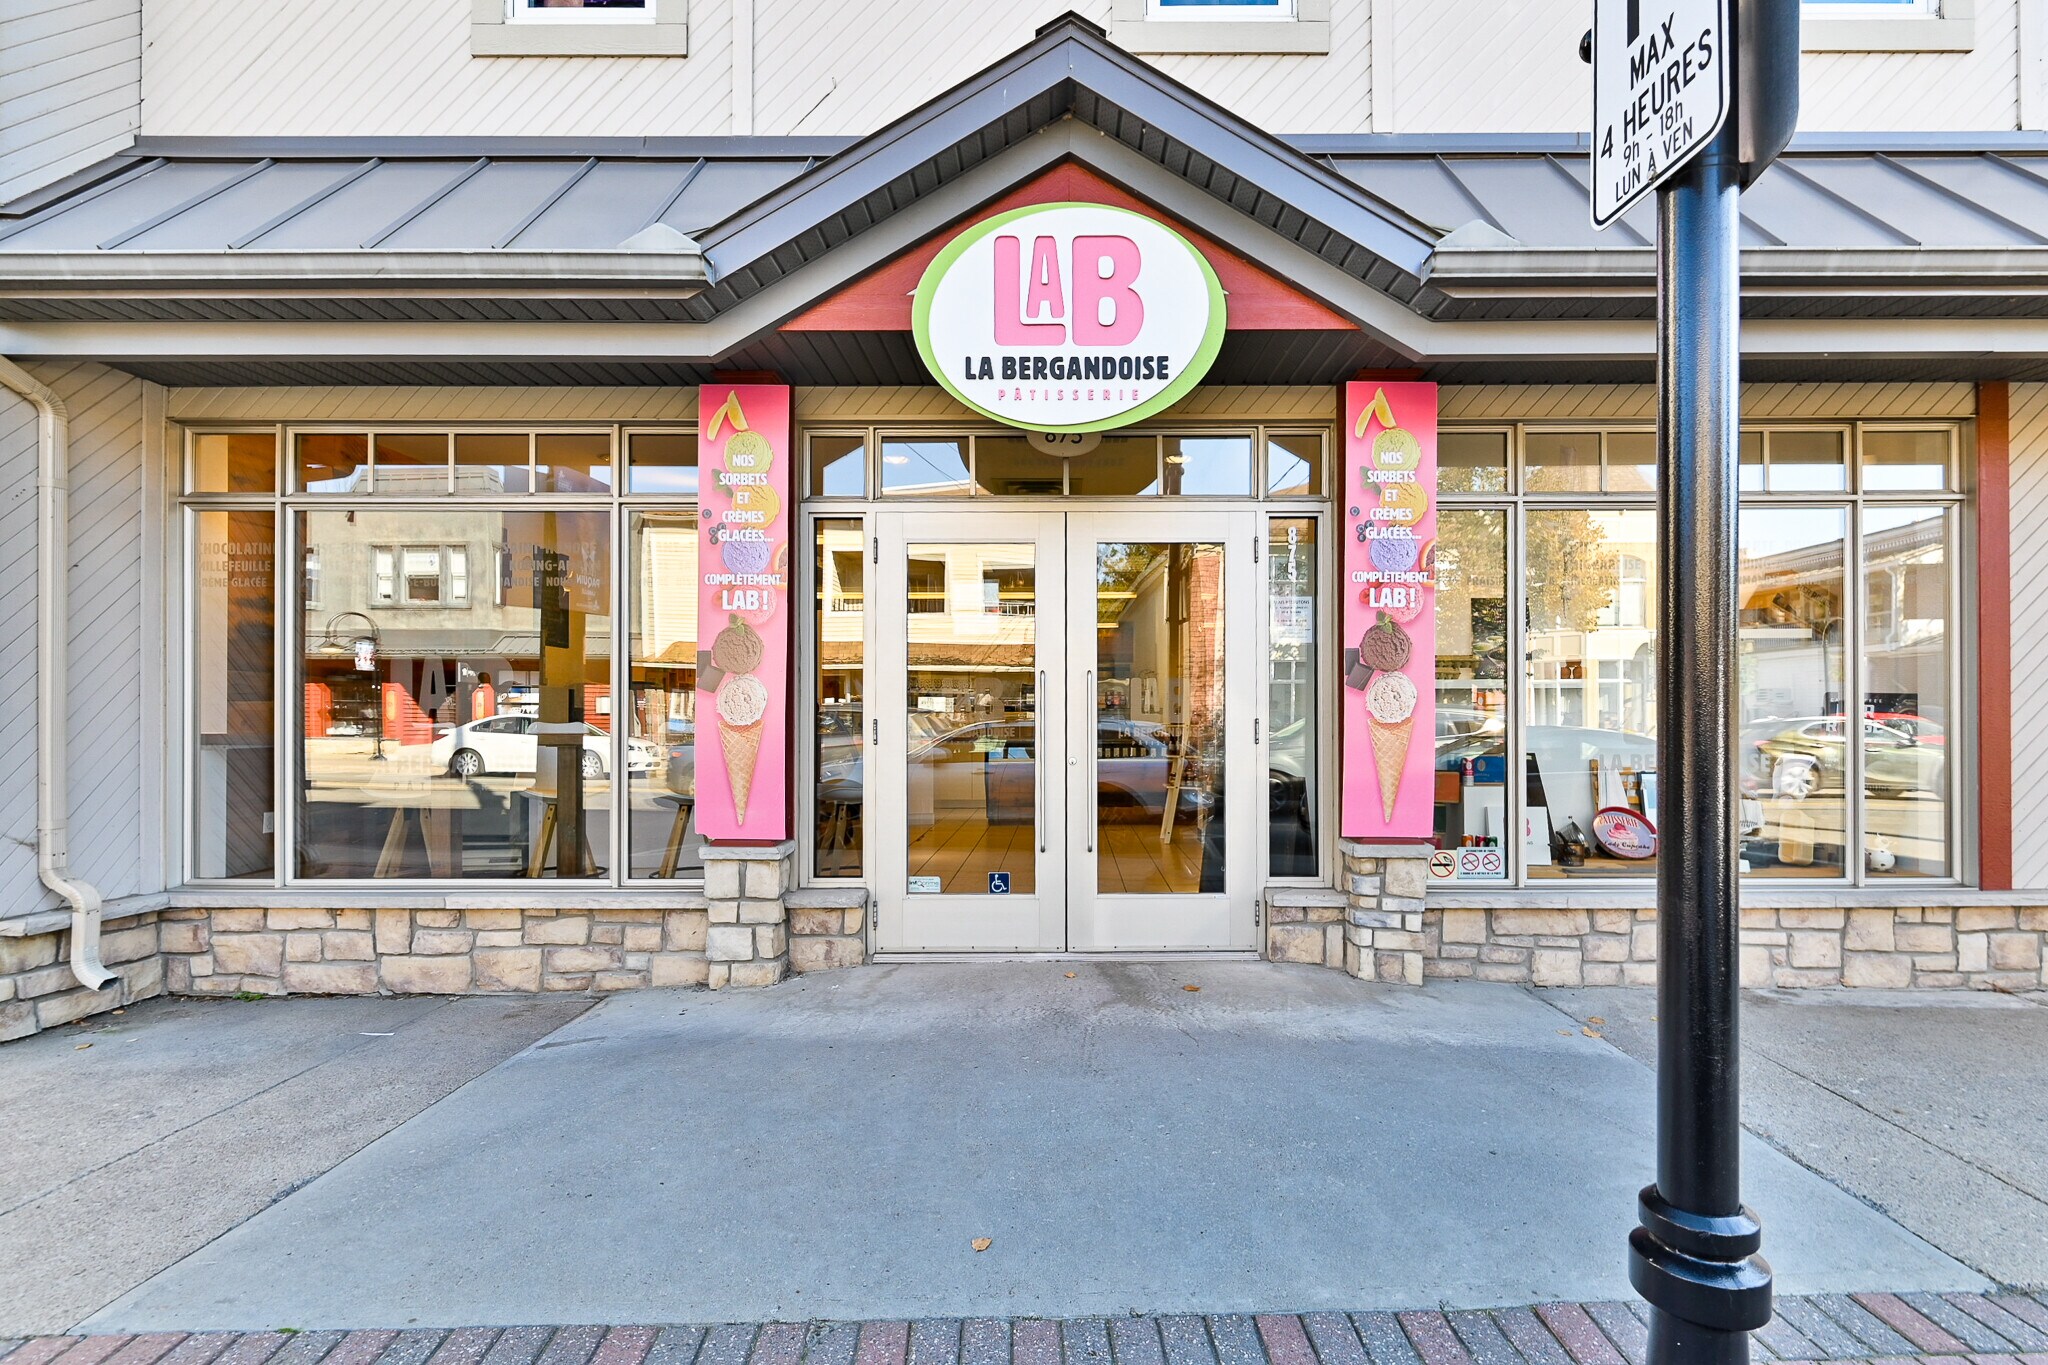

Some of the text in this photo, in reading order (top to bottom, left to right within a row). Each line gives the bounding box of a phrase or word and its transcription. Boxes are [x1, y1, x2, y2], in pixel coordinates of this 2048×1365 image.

[1630, 12, 1674, 90] MAX
[1601, 28, 1712, 158] 4 HEURES
[1624, 140, 1639, 167] 9h
[1660, 101, 1683, 136] 18h
[1616, 163, 1641, 203] LUN
[1663, 117, 1693, 160] VEN
[994, 235, 1144, 346] LAB
[965, 355, 1169, 381] LA BERGANDOISE
[998, 387, 1140, 401] PÂTISSERIE
[732, 454, 755, 467] NOS
[1380, 451, 1403, 464] NOS
[719, 473, 768, 485] SORBETS
[1367, 470, 1415, 483] SORBETS
[736, 492, 750, 504] ET
[1384, 489, 1398, 501] ET
[721, 510, 764, 523] CRÈMES
[1369, 507, 1412, 520] CRÈMES
[704, 572, 781, 585] COMPLÈTEMENT
[1351, 569, 1428, 583] COMPLÈTEMENT
